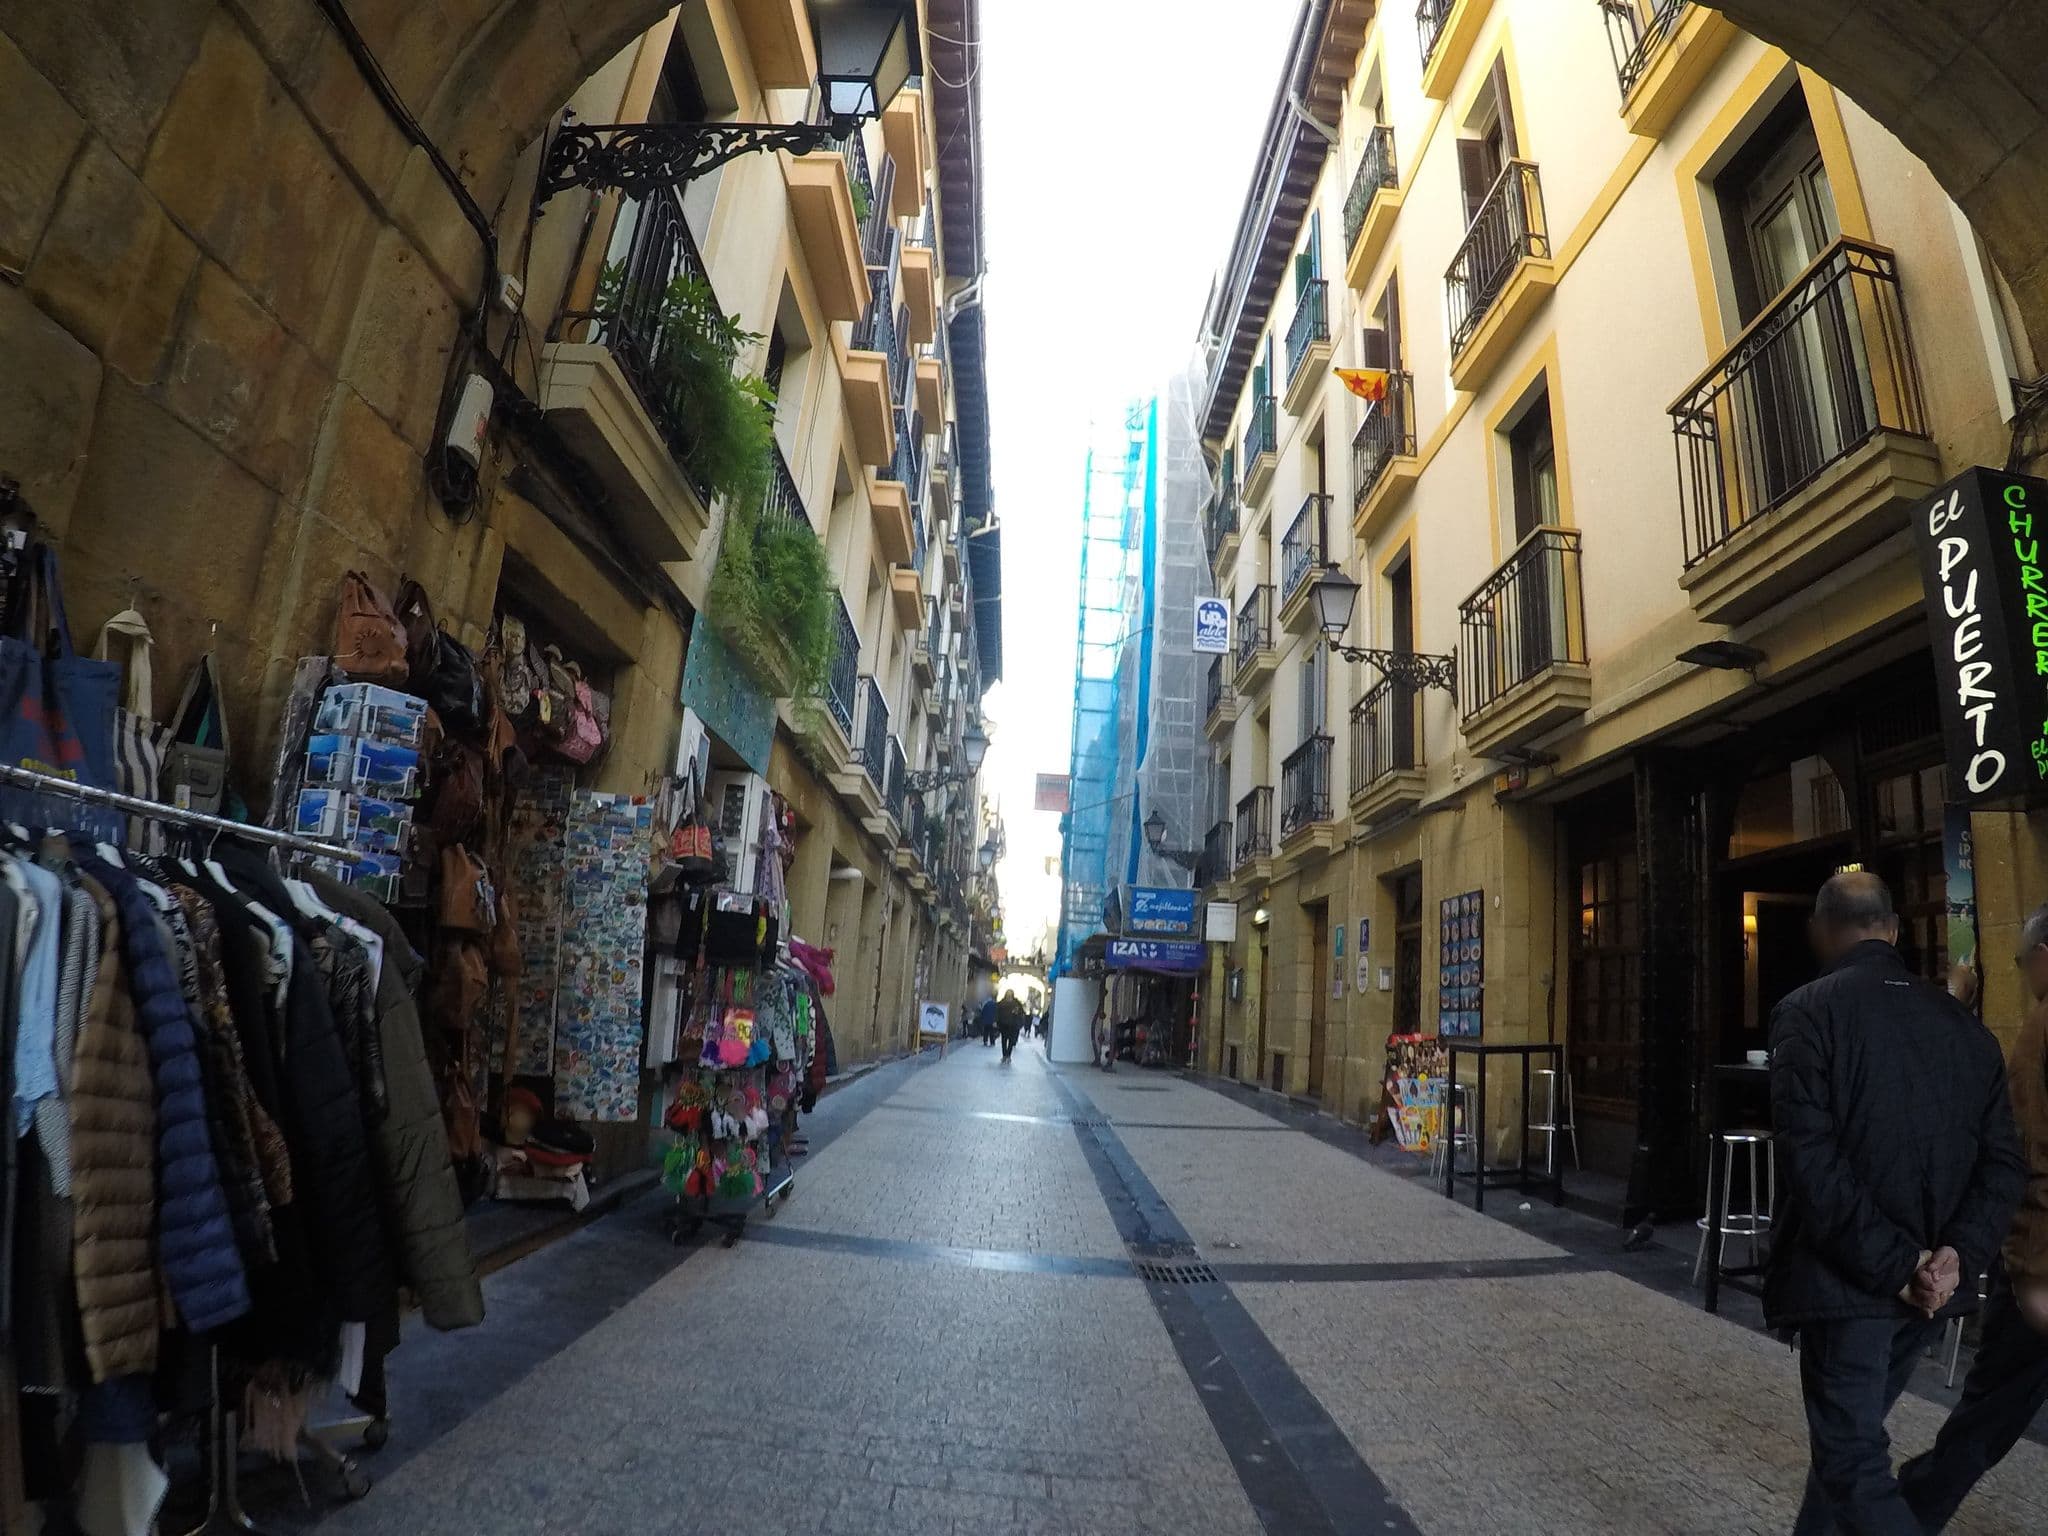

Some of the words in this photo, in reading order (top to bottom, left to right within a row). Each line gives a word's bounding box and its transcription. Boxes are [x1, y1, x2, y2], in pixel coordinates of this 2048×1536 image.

[1929, 488, 1965, 536] El
[2003, 485, 2048, 737] CHURRER
[1937, 537, 2006, 794] PUERTO
